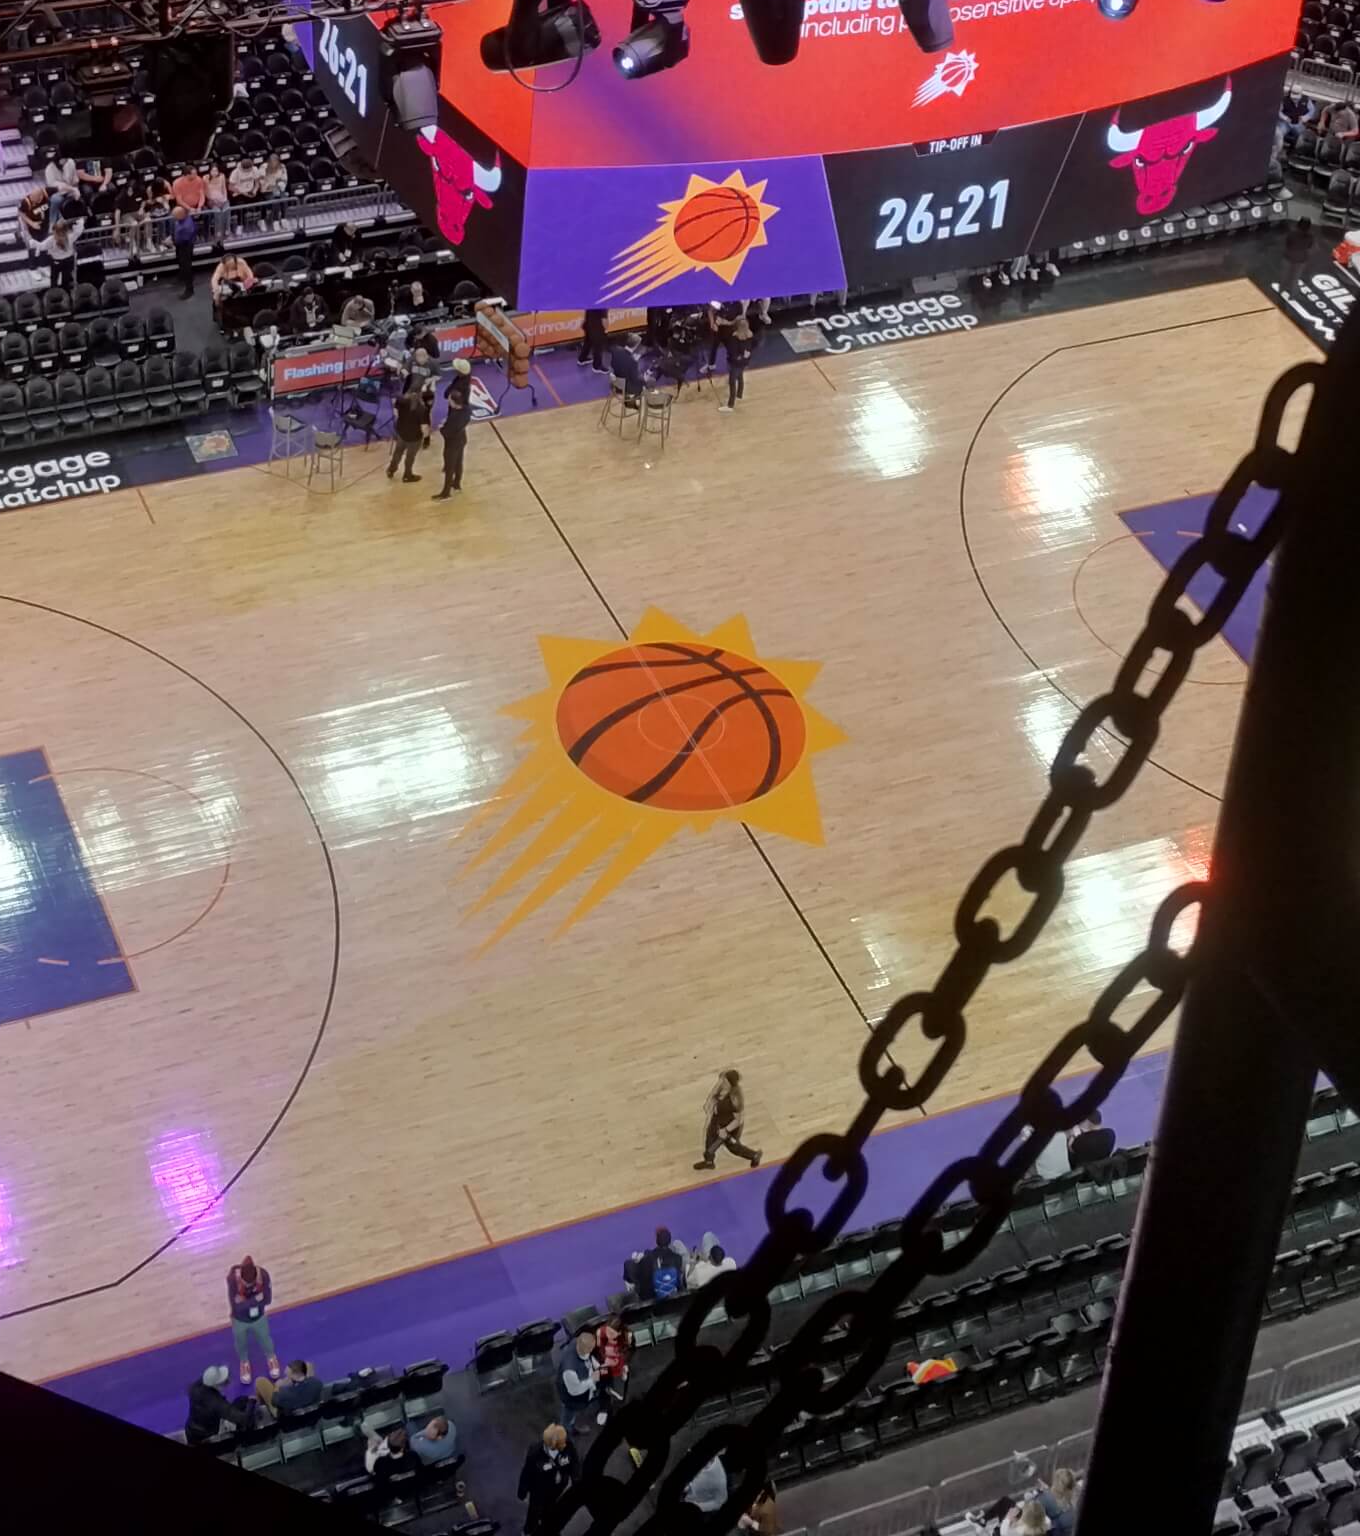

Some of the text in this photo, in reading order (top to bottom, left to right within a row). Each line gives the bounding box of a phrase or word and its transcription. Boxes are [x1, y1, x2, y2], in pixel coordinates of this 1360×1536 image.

[799, 13, 899, 40] including
[929, 134, 983, 155] TIP-OFF IN
[875, 179, 1010, 250] 26:21
[857, 314, 978, 346] matchup
[284, 361, 344, 381] Flashing
